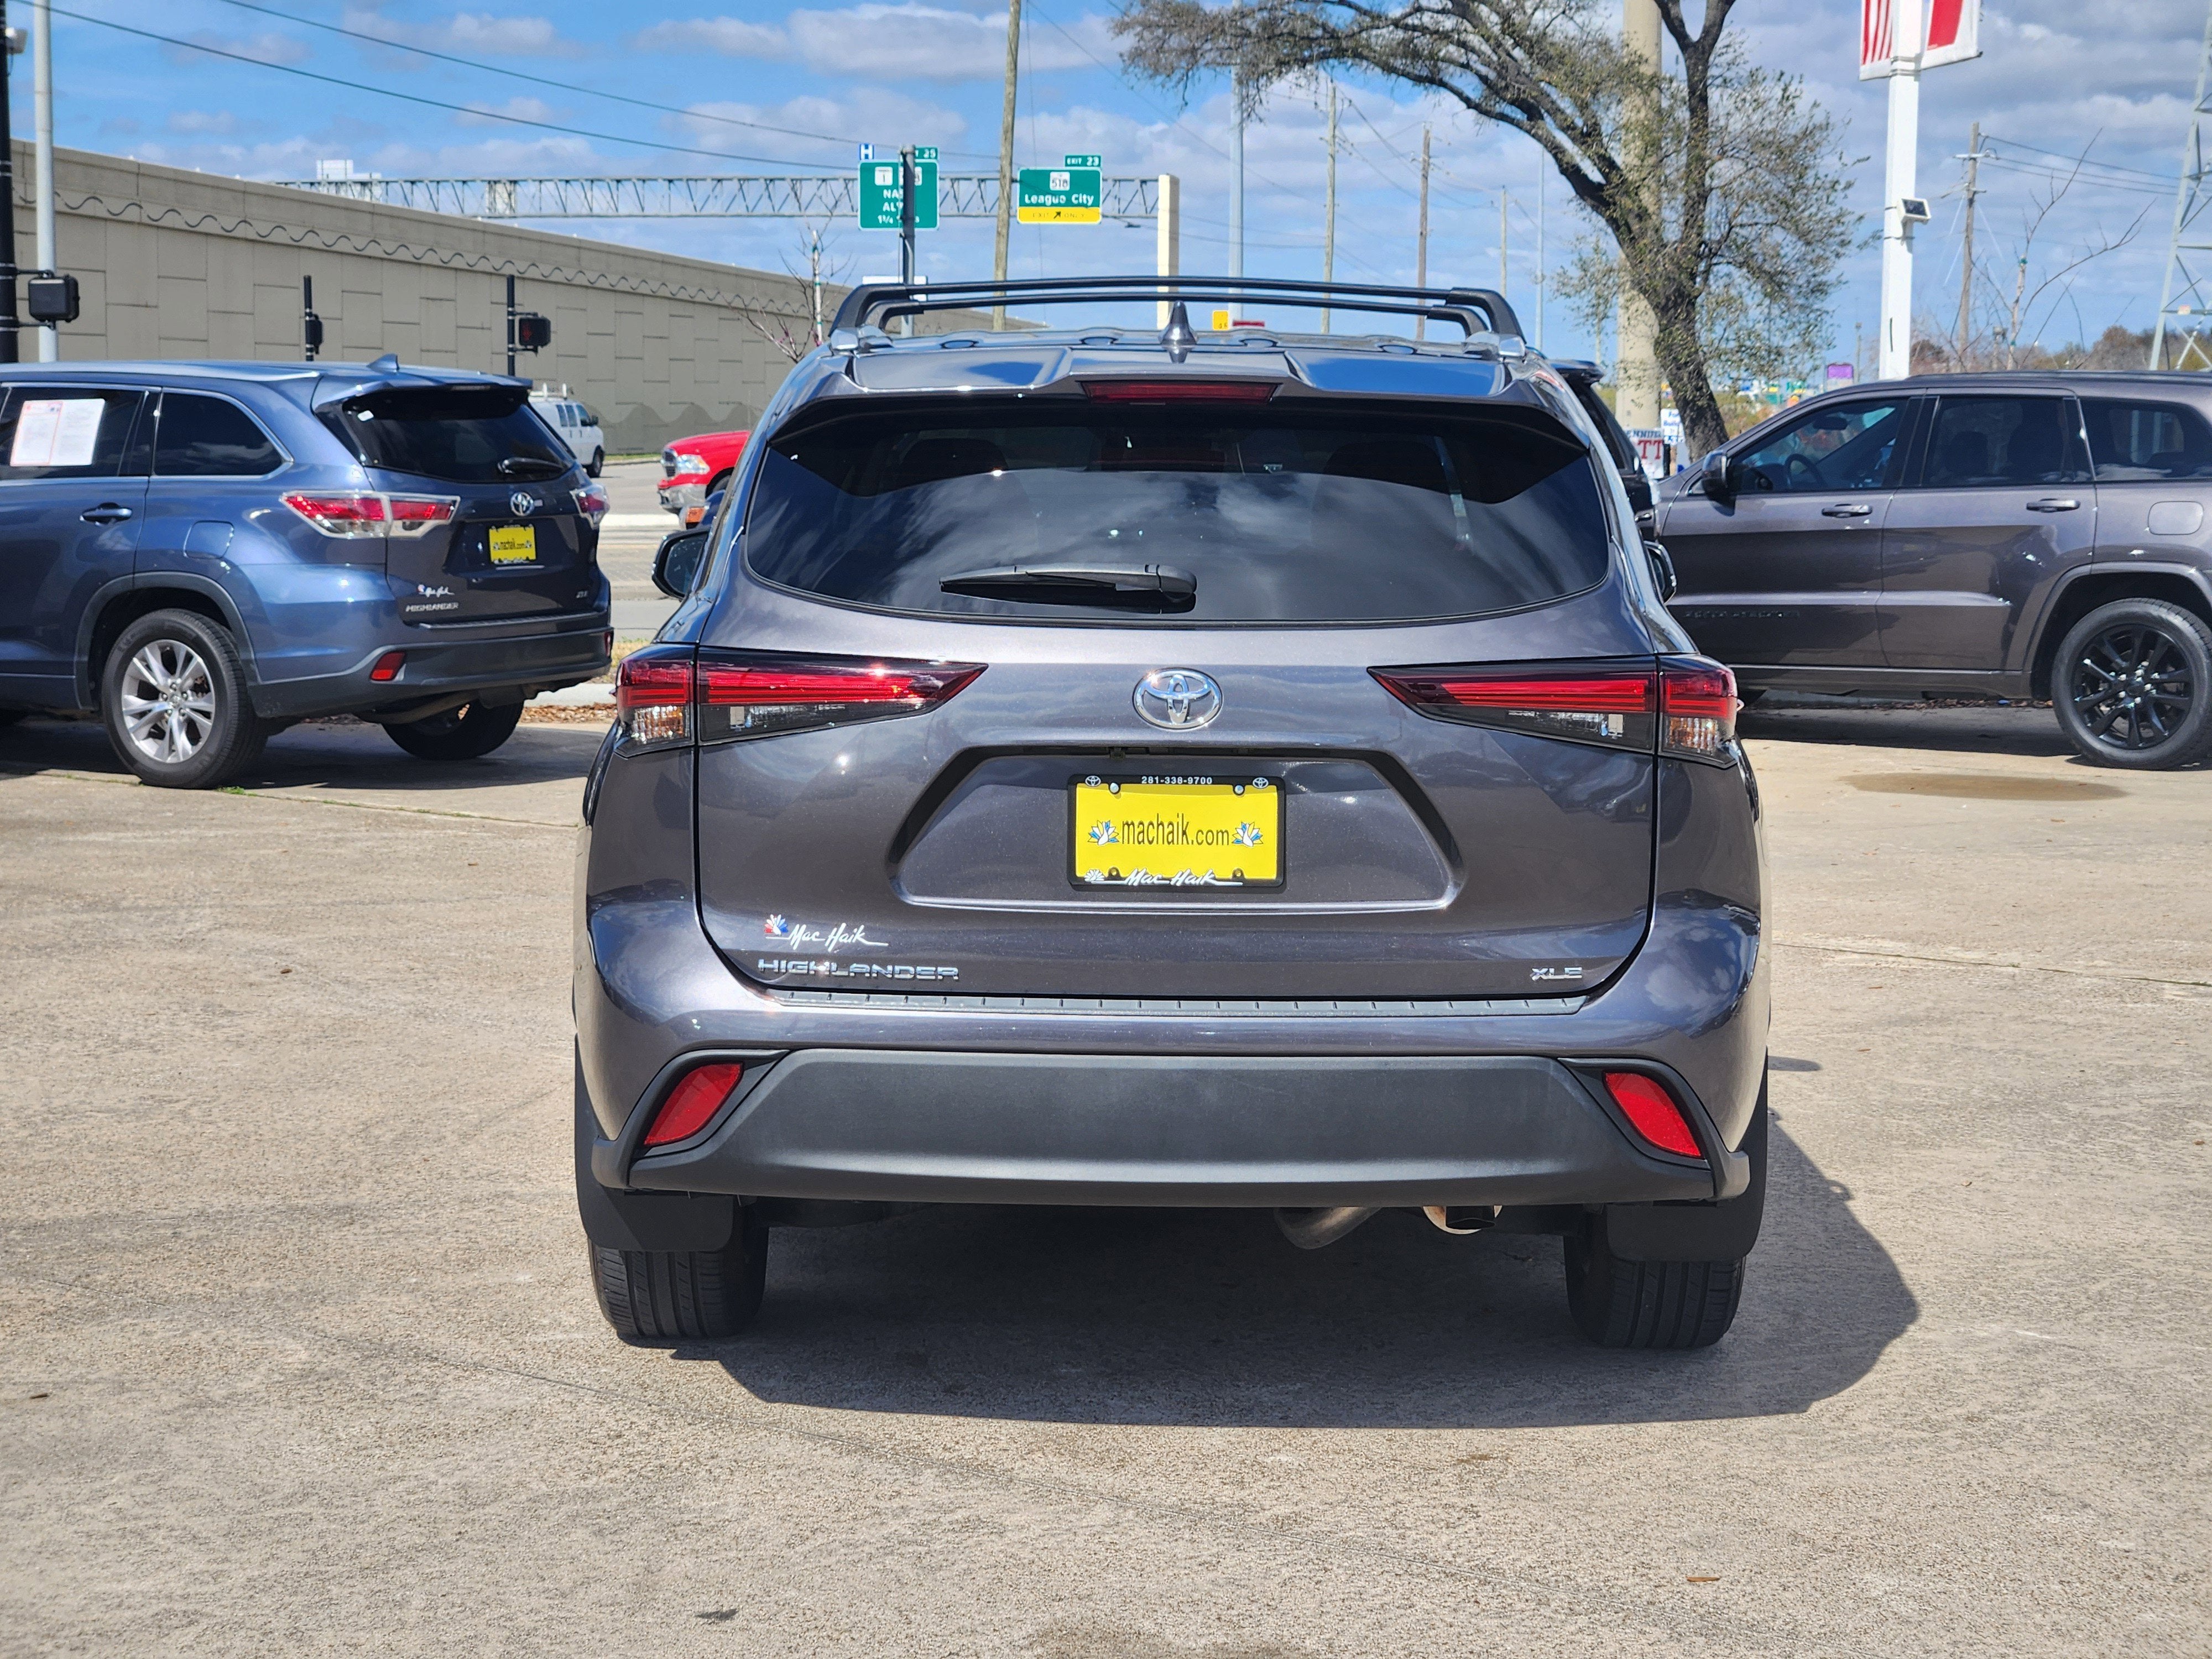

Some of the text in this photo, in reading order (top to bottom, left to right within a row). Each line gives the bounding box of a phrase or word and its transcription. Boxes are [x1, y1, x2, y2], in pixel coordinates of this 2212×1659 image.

[1086, 156, 1100, 166] 23
[1024, 193, 1094, 206] League City
[1141, 775, 1213, 785] 281-338-9700
[1121, 813, 1230, 846] machaik.com
[1124, 867, 1241, 886] Mac Haik
[787, 922, 889, 952] Mac Haik
[758, 958, 959, 980] HIGHLANDER
[1530, 967, 1583, 981] XLE
